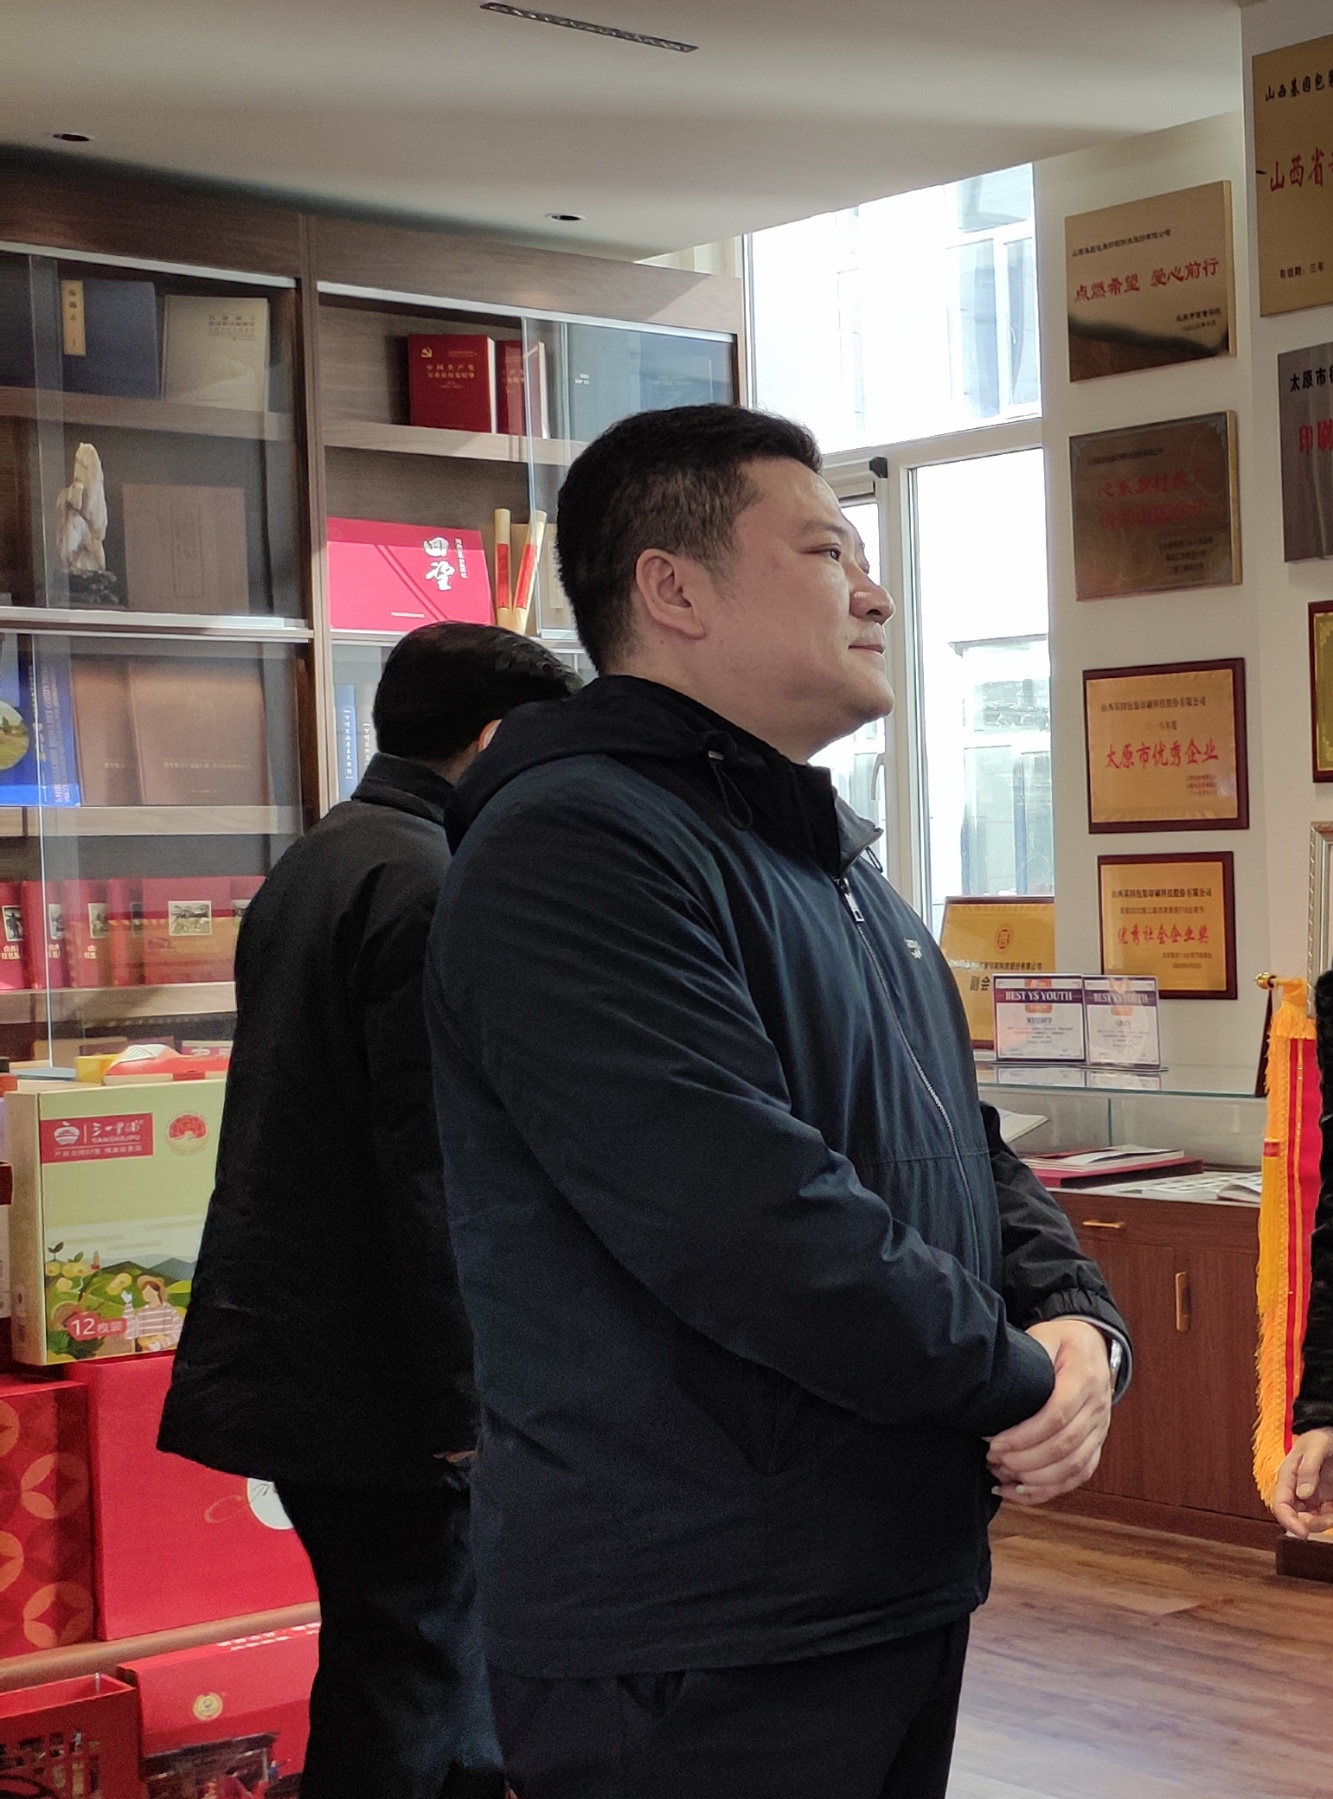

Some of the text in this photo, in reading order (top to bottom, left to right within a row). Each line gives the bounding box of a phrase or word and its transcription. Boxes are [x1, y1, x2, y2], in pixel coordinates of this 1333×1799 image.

[1074, 258, 1219, 302] 点燃希望 爱心前行
[1105, 738, 1219, 770] 太原市优秀企业
[1005, 990, 1027, 1001] BEST
[1040, 990, 1073, 1000] YOUTH
